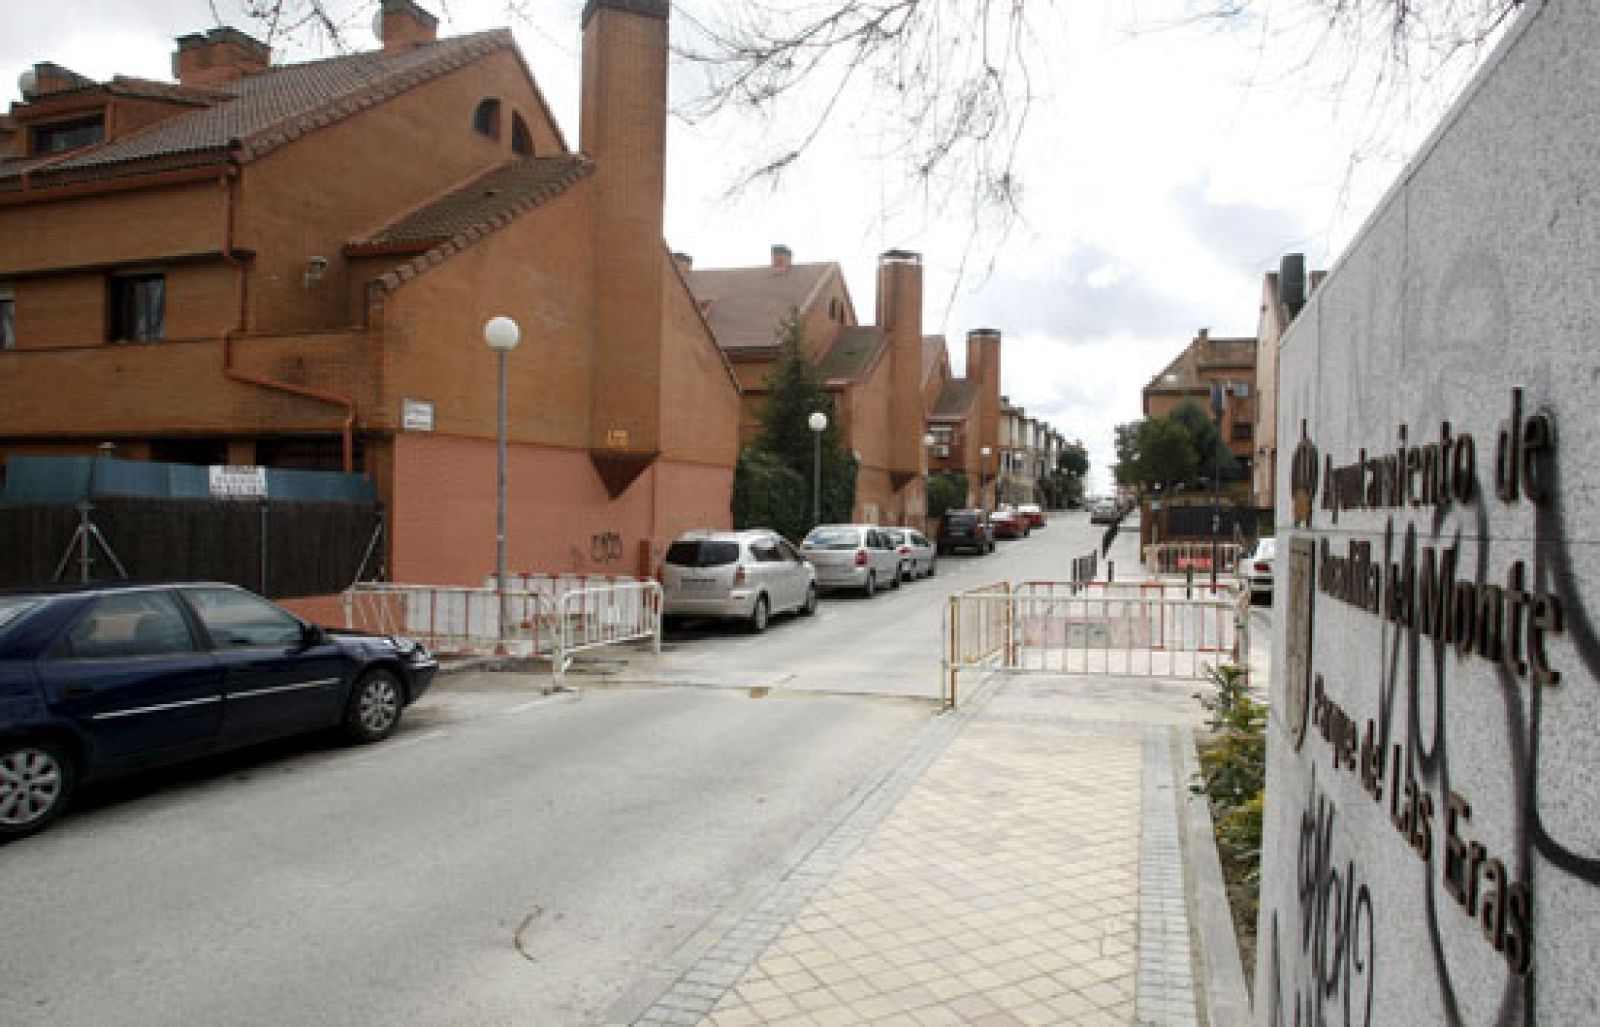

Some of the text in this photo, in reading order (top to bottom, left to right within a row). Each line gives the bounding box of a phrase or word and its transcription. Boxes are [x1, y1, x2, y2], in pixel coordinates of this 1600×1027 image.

[1497, 386, 1552, 503] de
[1419, 547, 1563, 686] Monte
[1390, 744, 1434, 862] Las
[1443, 790, 1531, 976] Eras
